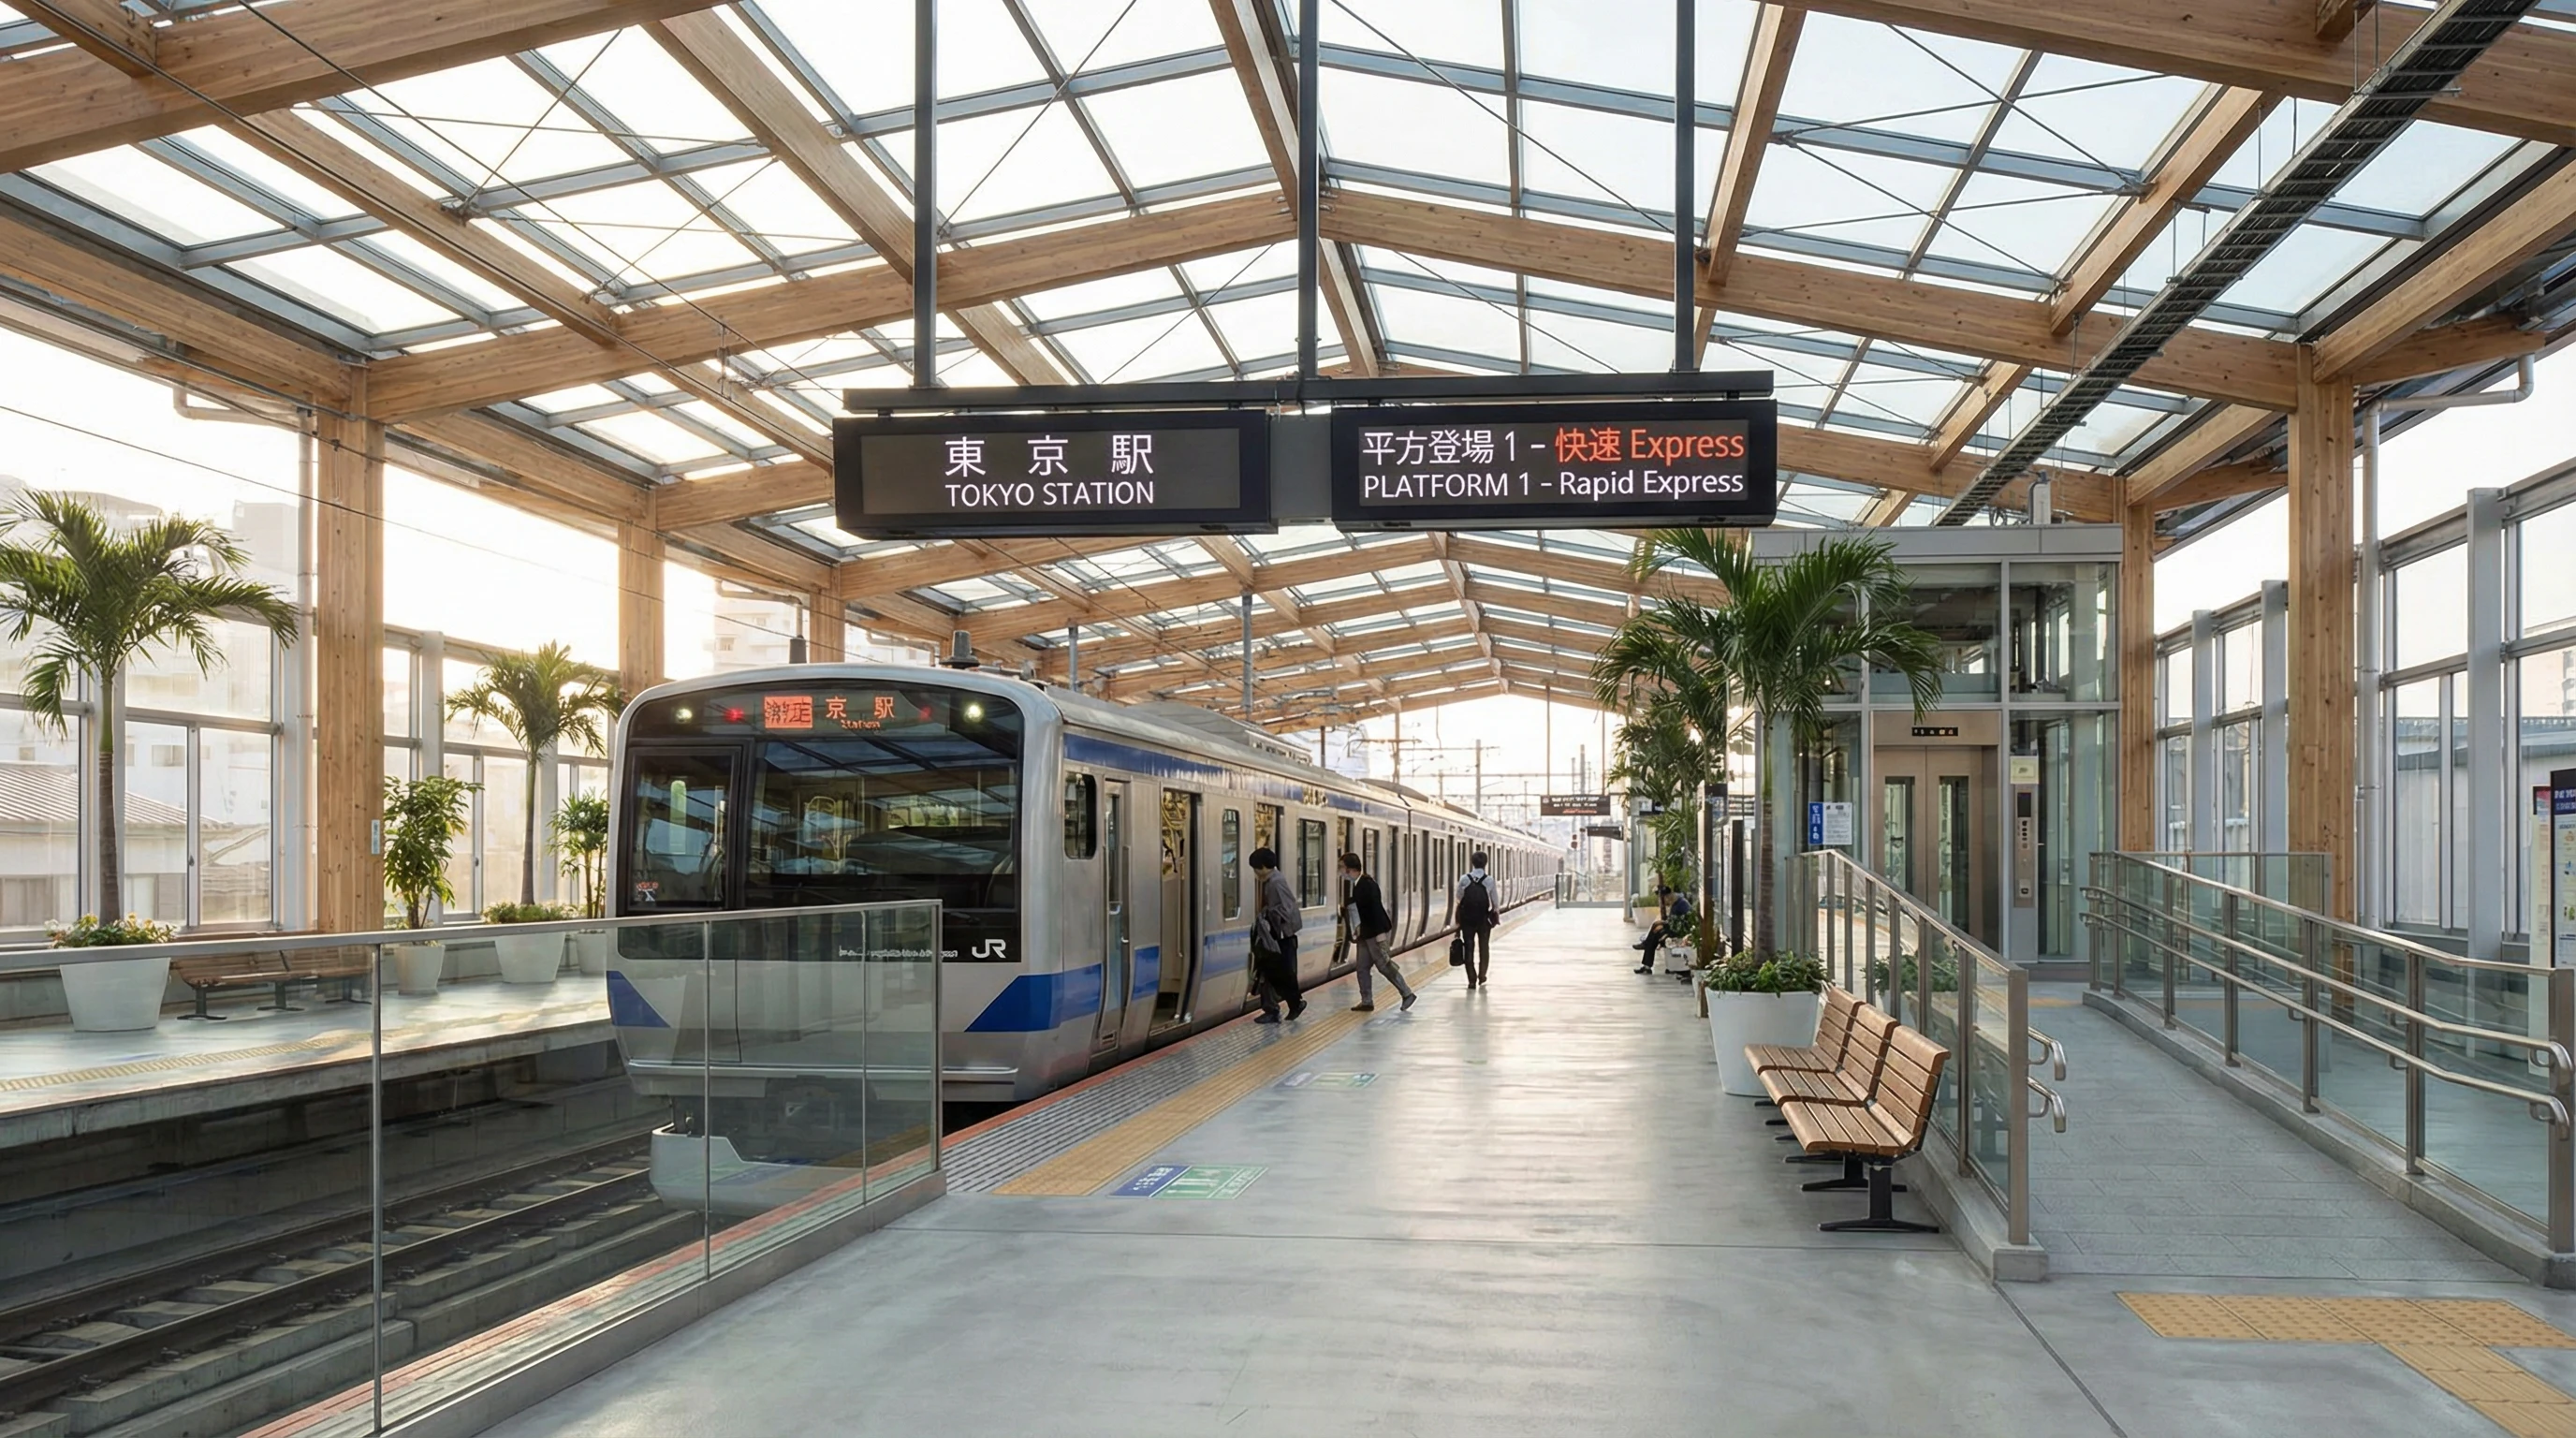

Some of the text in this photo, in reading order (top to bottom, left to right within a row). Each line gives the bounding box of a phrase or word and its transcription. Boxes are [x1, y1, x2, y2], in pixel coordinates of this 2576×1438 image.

[1363, 430, 1494, 466] 平方登場
[1504, 432, 1515, 462] 1
[1556, 427, 1622, 462] 快速
[1631, 430, 1744, 463] Express
[944, 480, 1154, 507] TOKYO STATION
[1364, 472, 1508, 499] PLATFORM
[1518, 471, 1529, 496] 1
[1560, 469, 1634, 502] Rapid
[1644, 470, 1744, 500] Express
[972, 938, 1006, 959] JR
